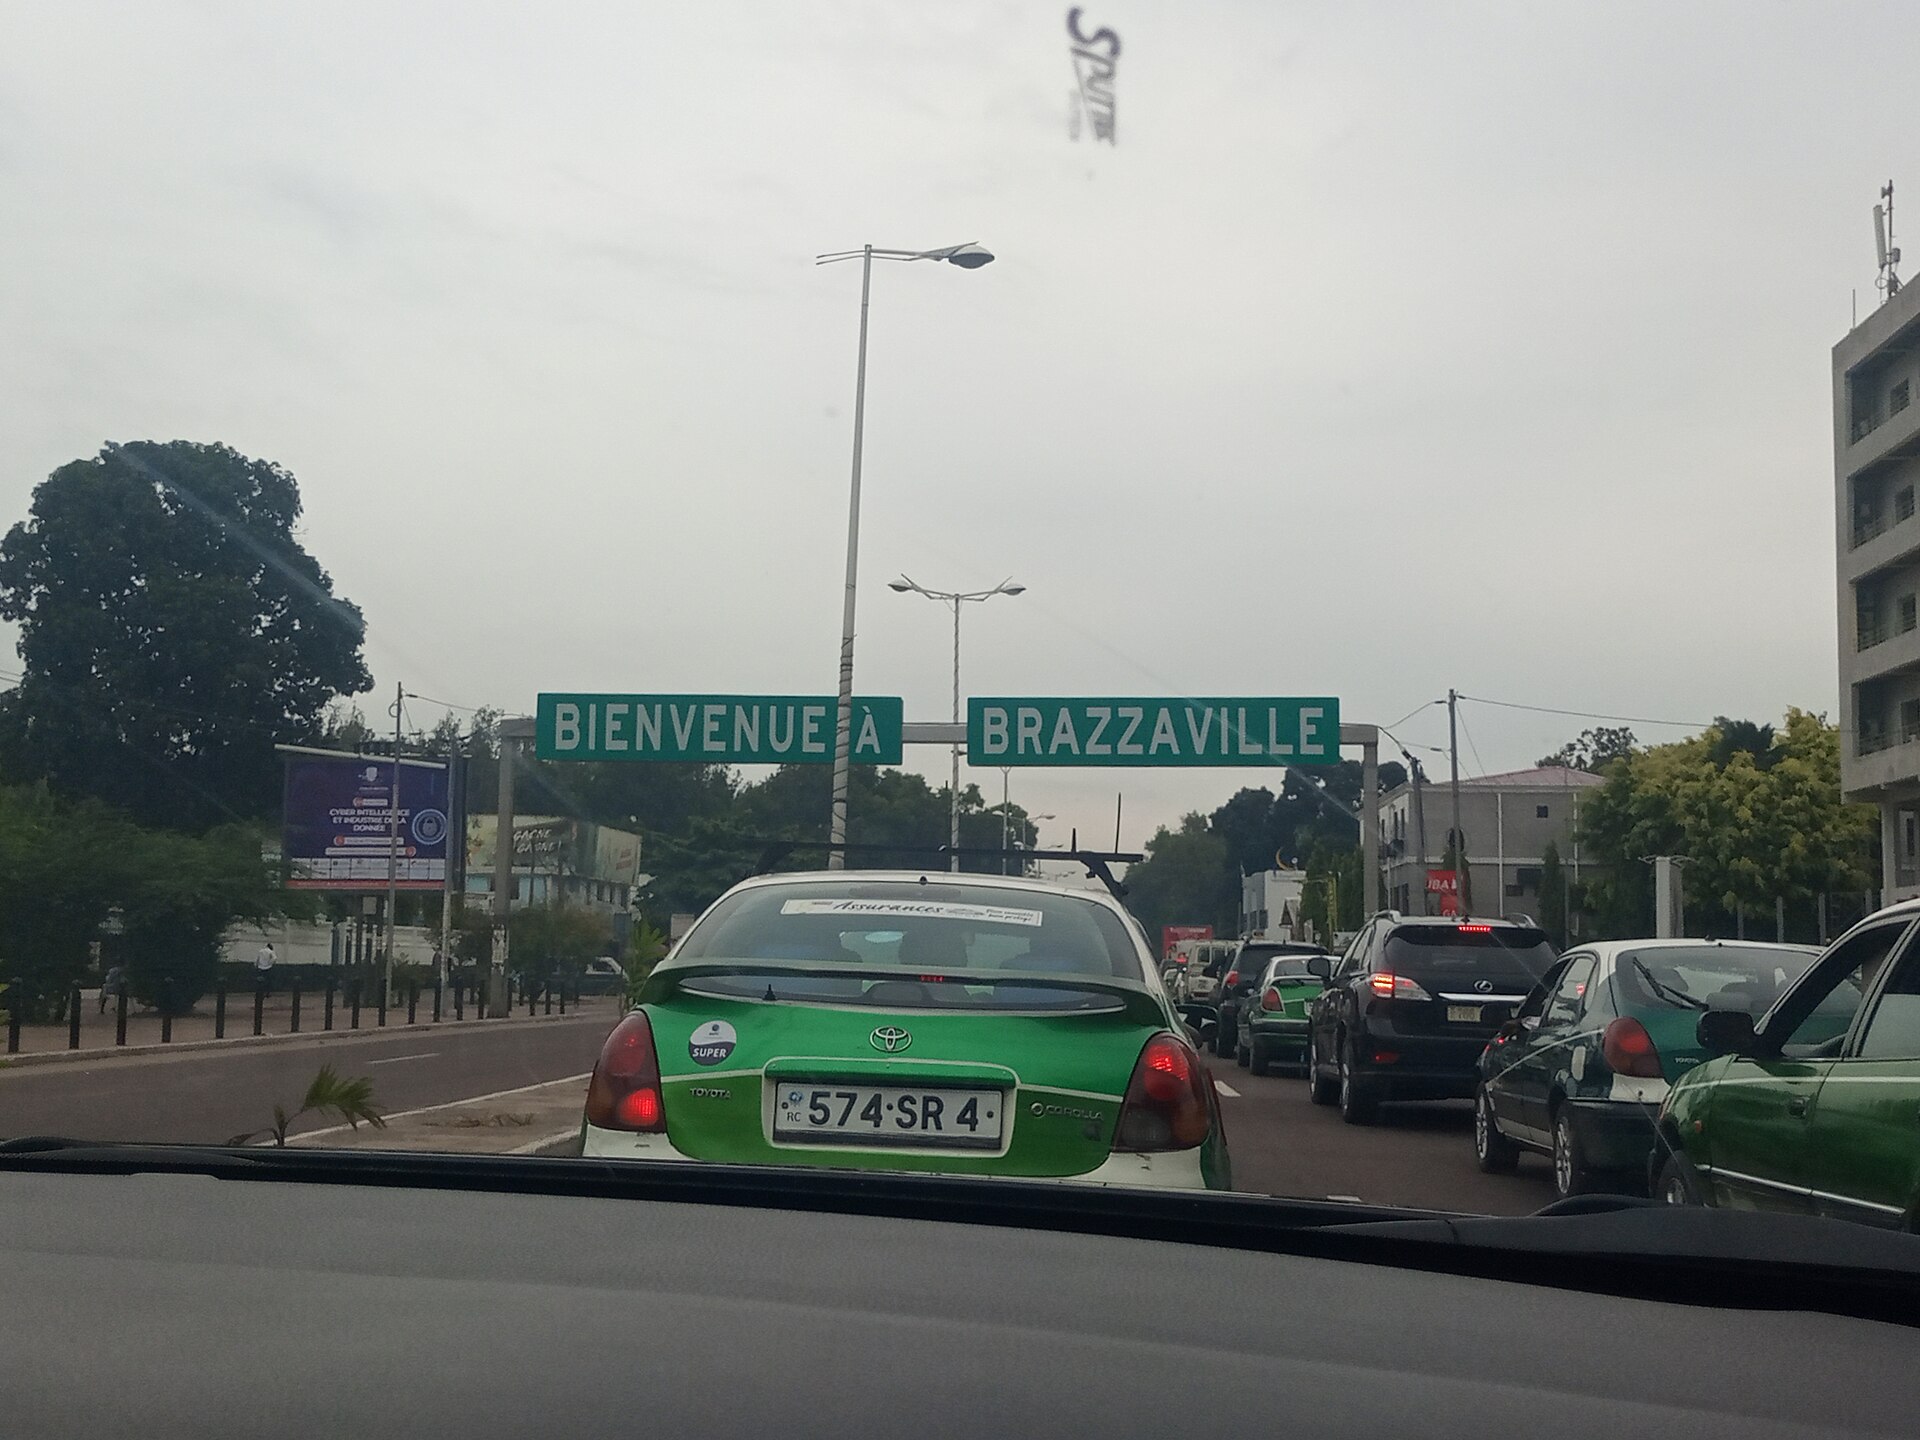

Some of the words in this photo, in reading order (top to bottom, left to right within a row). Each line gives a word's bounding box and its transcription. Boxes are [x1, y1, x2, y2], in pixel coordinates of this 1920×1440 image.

[554, 702, 827, 754] BIENVENUE
[854, 705, 882, 754] À
[983, 706, 1325, 755] BRAZZAVILLE
[329, 808, 356, 816] CYBER
[833, 901, 944, 914] Assurances
[692, 1047, 727, 1059] SUPER
[689, 1087, 732, 1099] TOYOTA
[786, 1111, 801, 1122] RC
[808, 1090, 884, 1128] 574
[895, 1095, 944, 1131] SR
[956, 1096, 979, 1132] 4
[1045, 1104, 1105, 1121] COROLLA
